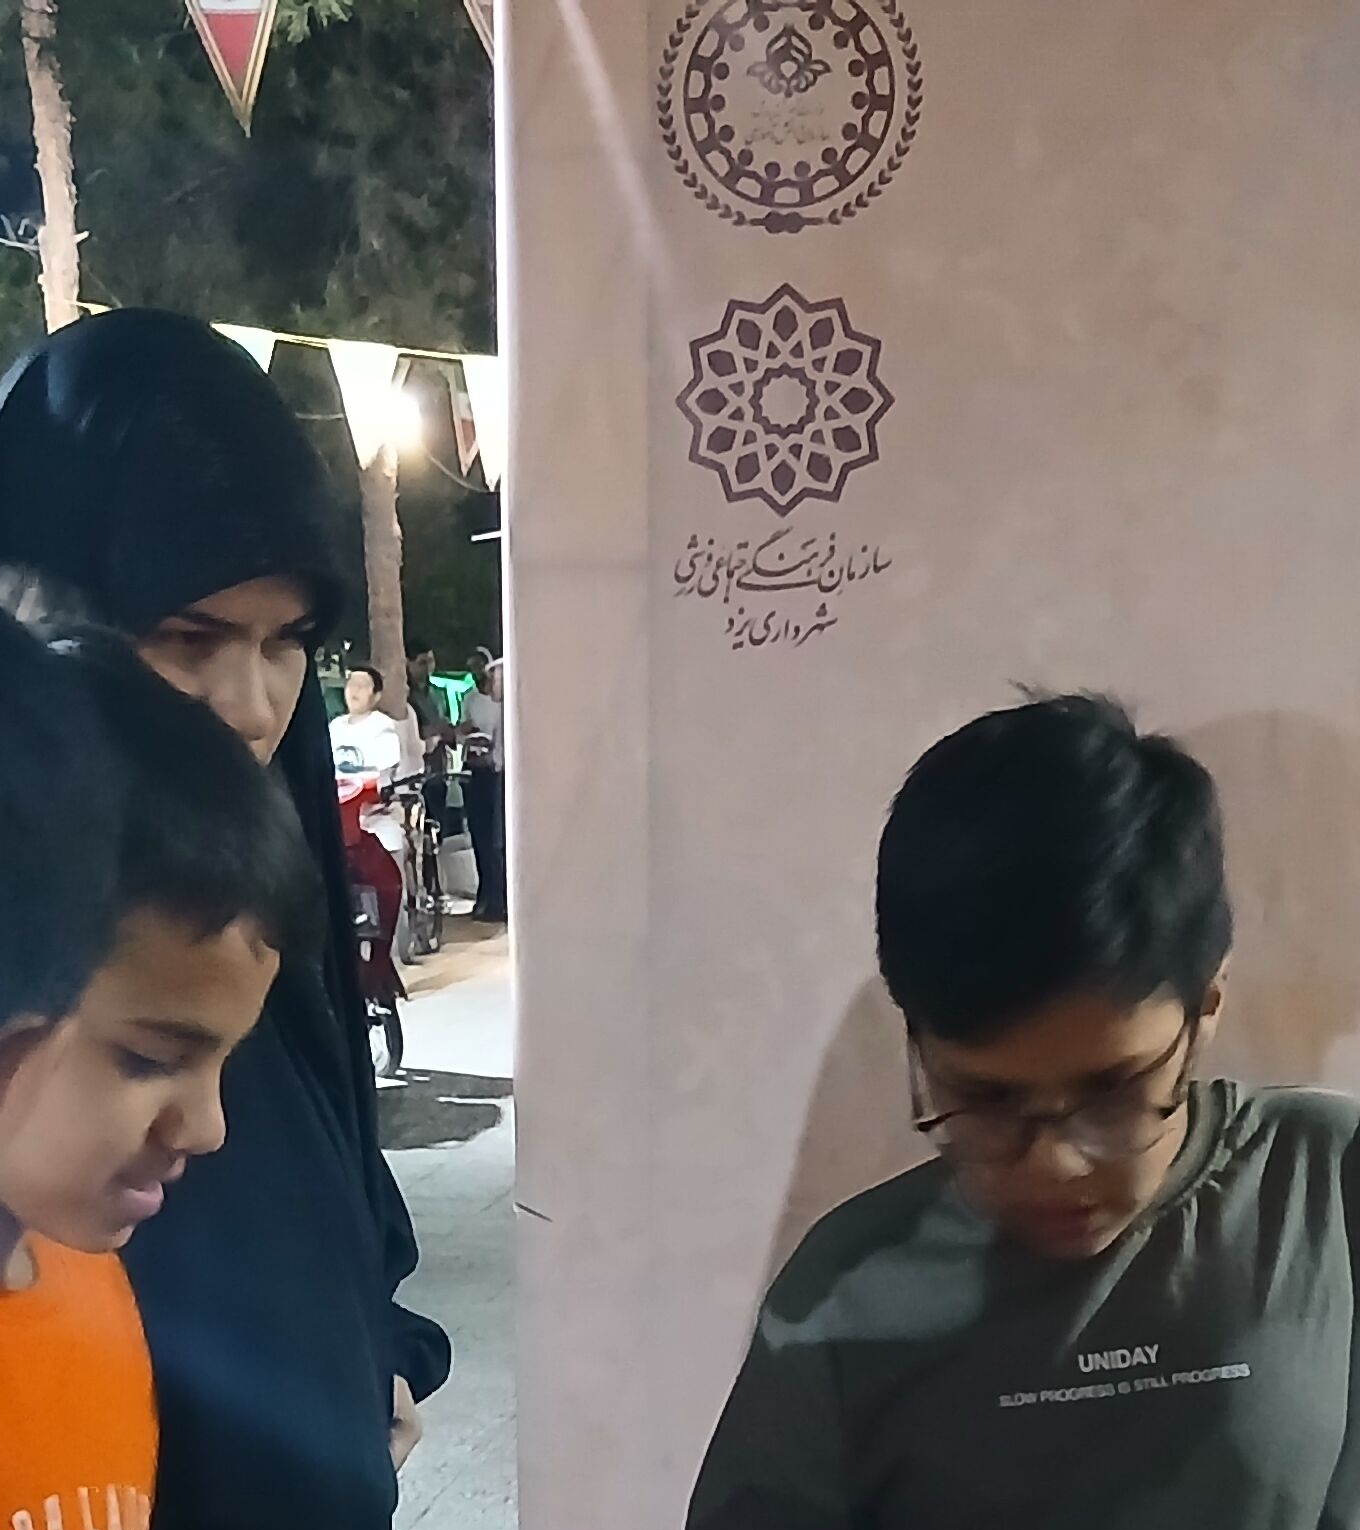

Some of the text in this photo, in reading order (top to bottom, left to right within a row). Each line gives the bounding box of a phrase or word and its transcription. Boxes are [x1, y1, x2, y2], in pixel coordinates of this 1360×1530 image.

[817, 544, 892, 595] سازمان
[724, 602, 839, 651] شهرداری یزد
